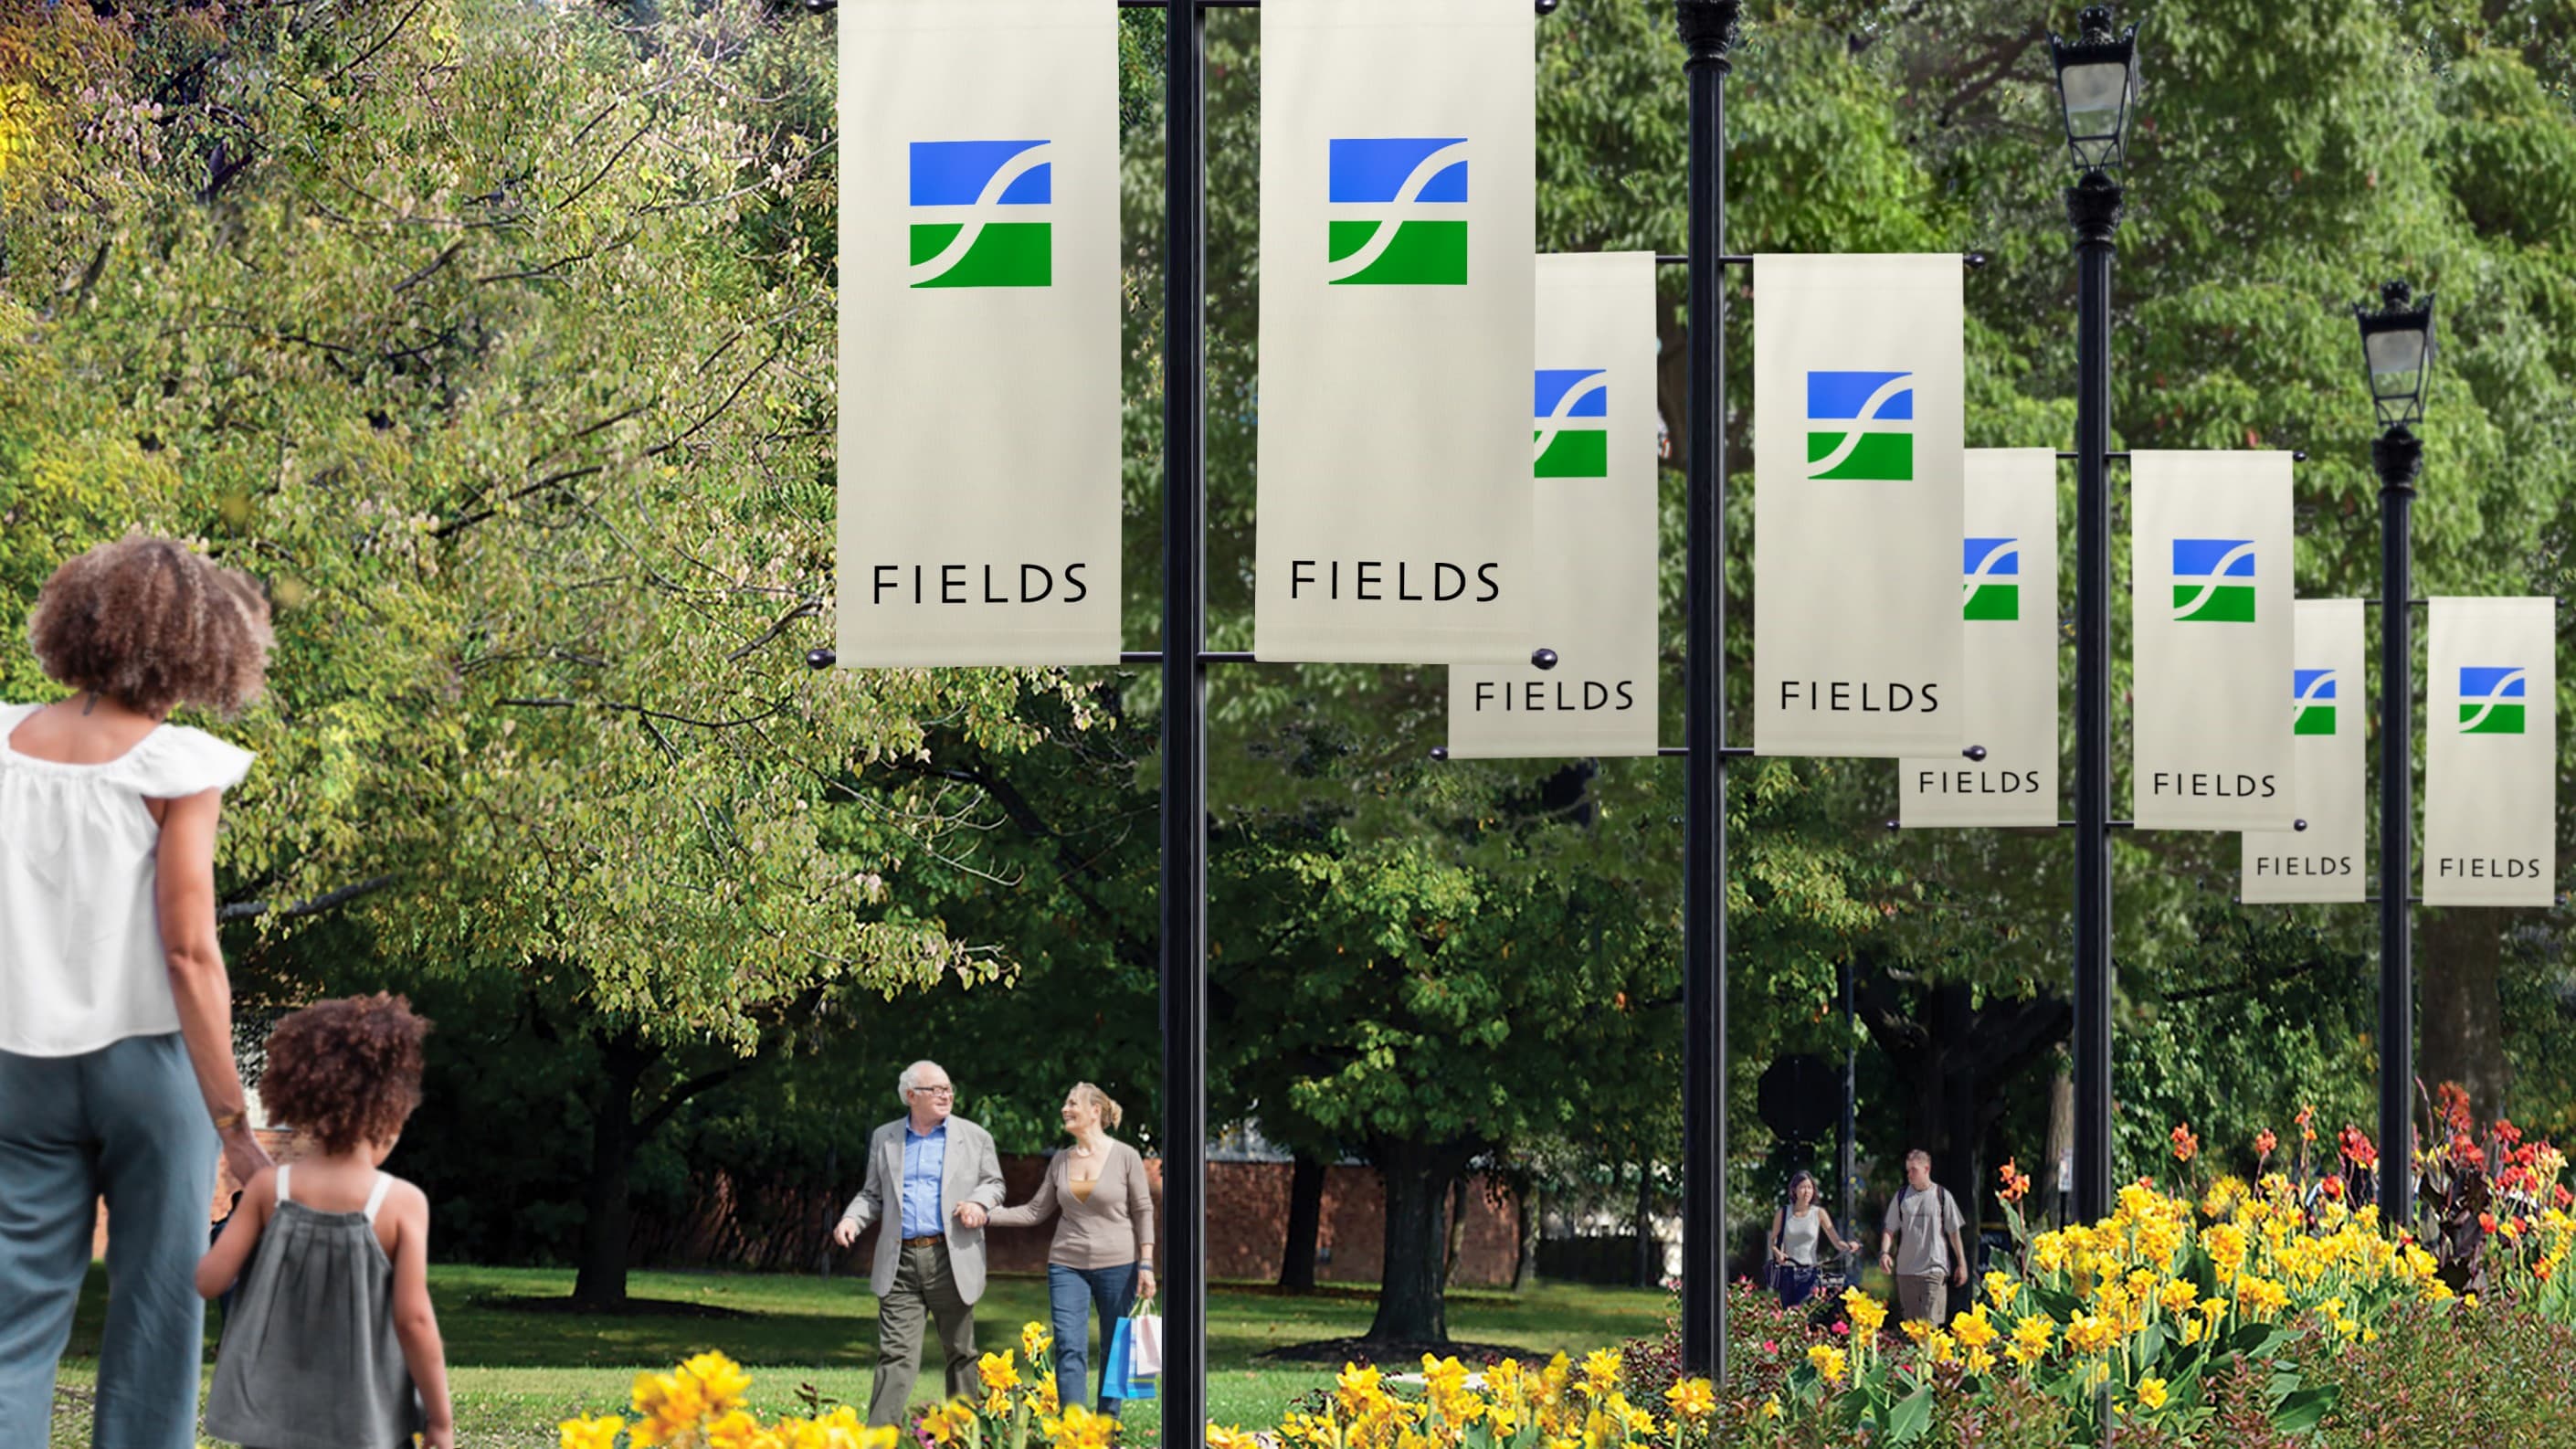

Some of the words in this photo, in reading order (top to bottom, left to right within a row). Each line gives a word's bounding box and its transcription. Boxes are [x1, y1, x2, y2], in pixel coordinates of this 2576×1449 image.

[874, 564, 1087, 605] FIELDS
[1292, 561, 1499, 603] FIELDS
[1475, 681, 1633, 712] FIELDS
[1782, 682, 1938, 713] FIELDS
[1920, 771, 2040, 794] FIELDS
[2154, 773, 2275, 798] FIELDS
[2257, 857, 2351, 876] FIELDS
[2440, 859, 2539, 879] FIELDS
